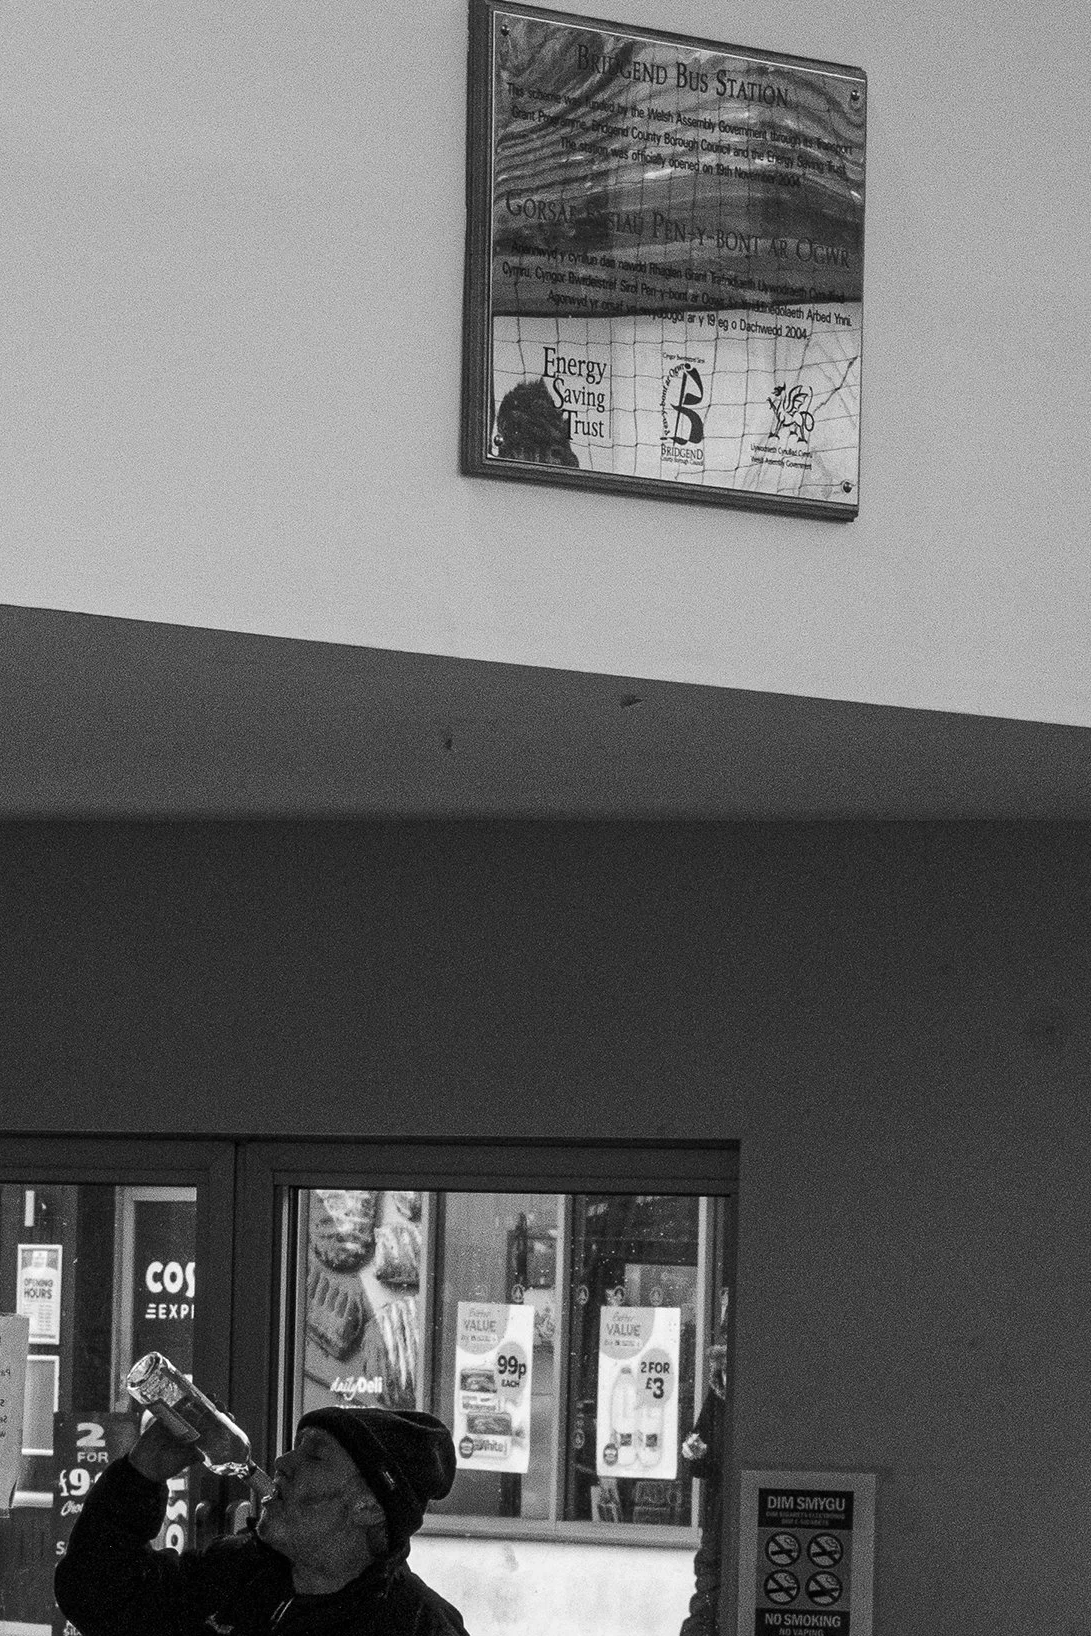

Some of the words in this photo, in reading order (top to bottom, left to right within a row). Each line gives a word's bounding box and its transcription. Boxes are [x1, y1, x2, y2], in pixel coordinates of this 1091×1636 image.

[676, 61, 709, 94] BUS
[716, 69, 790, 109] STATION
[630, 104, 645, 118] the
[647, 107, 674, 123] Welsh
[676, 110, 716, 133] Assembly
[718, 120, 768, 141] Government
[631, 126, 661, 144] County
[664, 133, 699, 151] Borough
[701, 139, 731, 156] Council
[733, 144, 749, 159] and
[751, 147, 764, 162] the
[767, 150, 795, 169] Energy
[561, 137, 576, 151] The
[632, 149, 667, 168] officially
[669, 157, 699, 173] opened
[702, 163, 714, 175] on
[716, 162, 733, 178] 19th
[769, 238, 789, 259] AR
[795, 236, 850, 268] OGWR
[687, 314, 697, 324] ar
[698, 315, 704, 328] y
[706, 312, 717, 327] 19
[717, 319, 729, 331] eg
[730, 320, 737, 330] o
[739, 318, 783, 337] Dachwedd
[806, 309, 832, 324] Arbed
[542, 346, 607, 385] Energy
[552, 377, 606, 414] Saving
[561, 408, 605, 440] Trust
[661, 443, 704, 461] BRIDGEND
[23, 1278, 54, 1288] OPENING
[23, 1288, 53, 1300] HOURS
[158, 1303, 195, 1319] EXP
[464, 1319, 497, 1333] VALUE
[606, 1323, 641, 1337] VALUE
[497, 1354, 527, 1380] 99p
[649, 1361, 671, 1374] FOR
[501, 1379, 521, 1389] EACH
[645, 1377, 665, 1400] £3
[76, 1422, 106, 1448] 2
[77, 1451, 109, 1464] FOR
[767, 1496, 794, 1509] DIM
[796, 1497, 846, 1512] SMYGU
[765, 1613, 782, 1625] NO
[783, 1614, 842, 1628] SMOKING
[779, 1628, 792, 1636] NO
